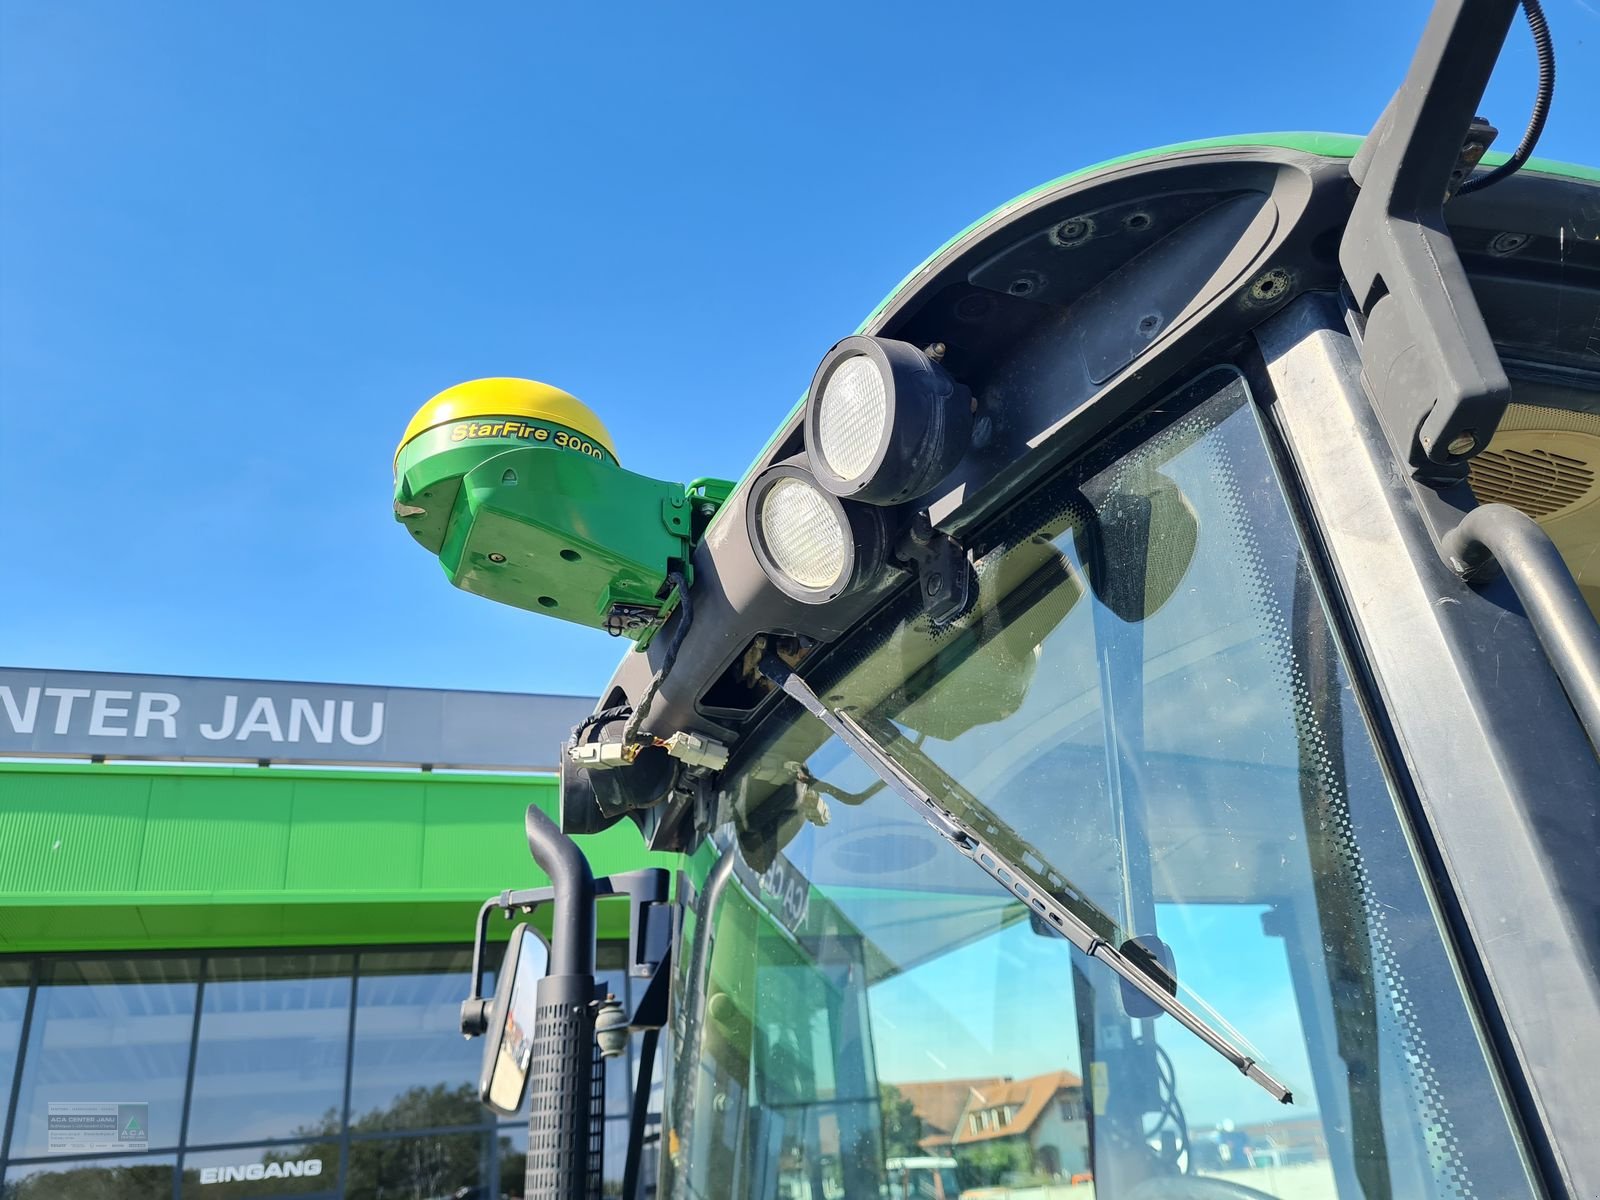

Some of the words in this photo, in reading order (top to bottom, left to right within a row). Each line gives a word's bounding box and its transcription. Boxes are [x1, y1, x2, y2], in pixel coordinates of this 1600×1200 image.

[450, 421, 550, 442] StarFire
[554, 431, 603, 460] 3000
[199, 695, 384, 745] JANU
[199, 1158, 323, 1185] EINGANG
